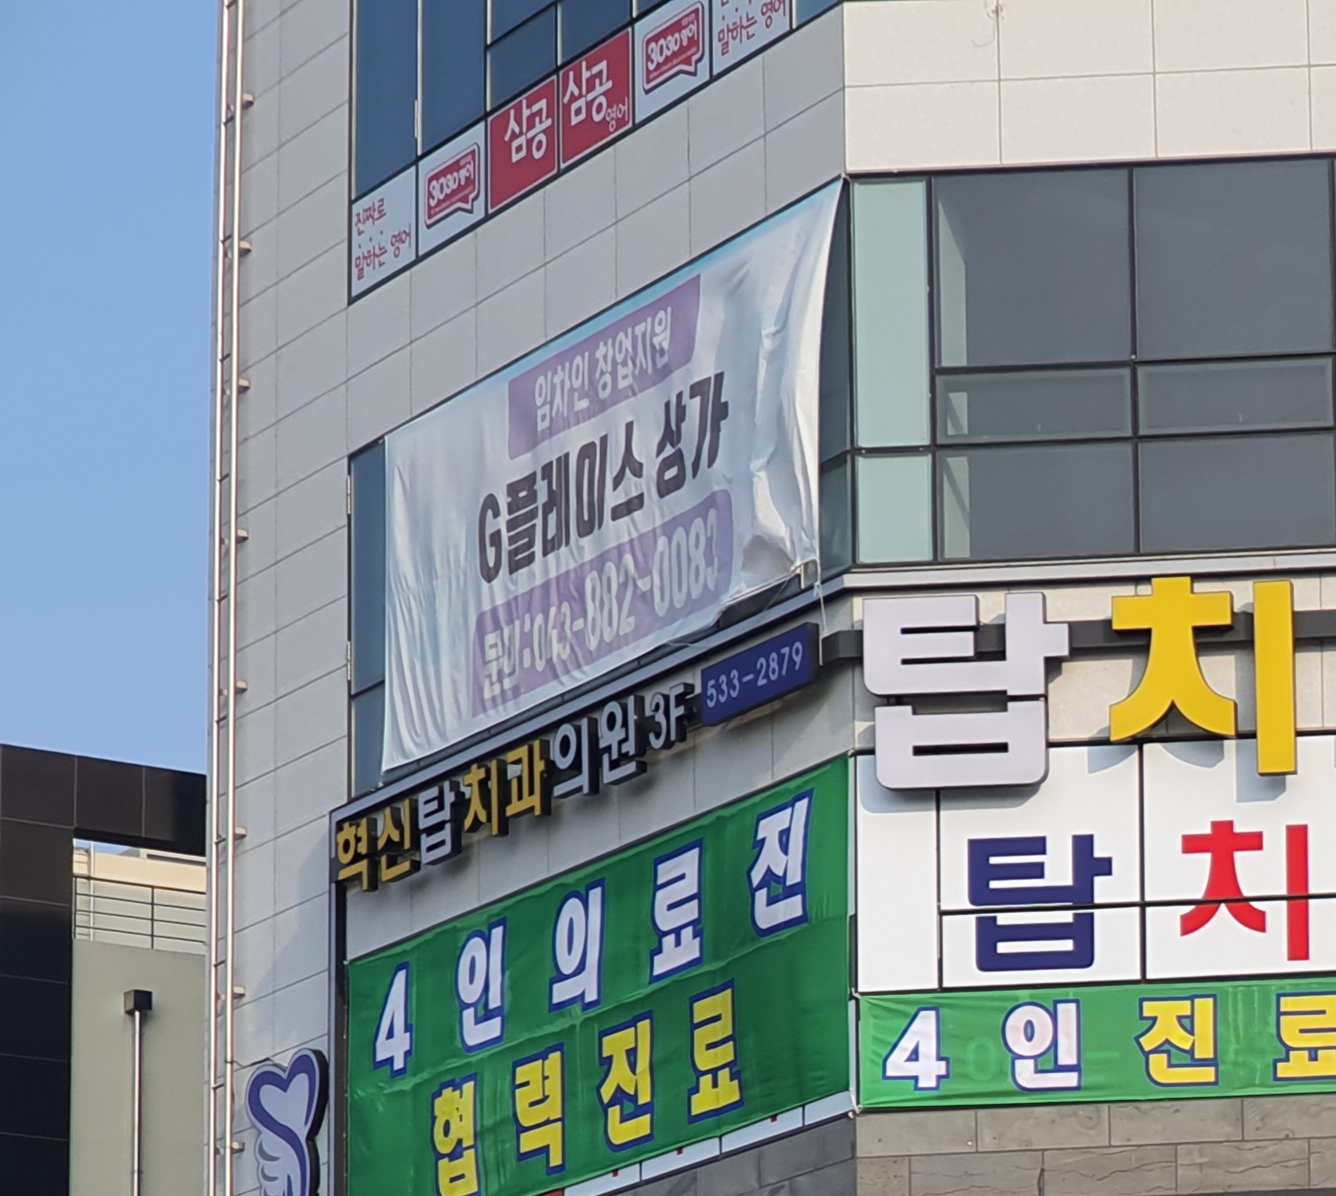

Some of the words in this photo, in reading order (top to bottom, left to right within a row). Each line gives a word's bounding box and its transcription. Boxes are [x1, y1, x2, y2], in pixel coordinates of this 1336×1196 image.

[504, 98, 553, 163] 삼공
[562, 59, 613, 127] 삼공
[534, 351, 590, 432] 임차인
[595, 306, 673, 401] 창업지원
[478, 420, 645, 585] G플레이스
[656, 370, 730, 499] 상가
[648, 684, 690, 749] 3F
[706, 641, 805, 709] 533-2879
